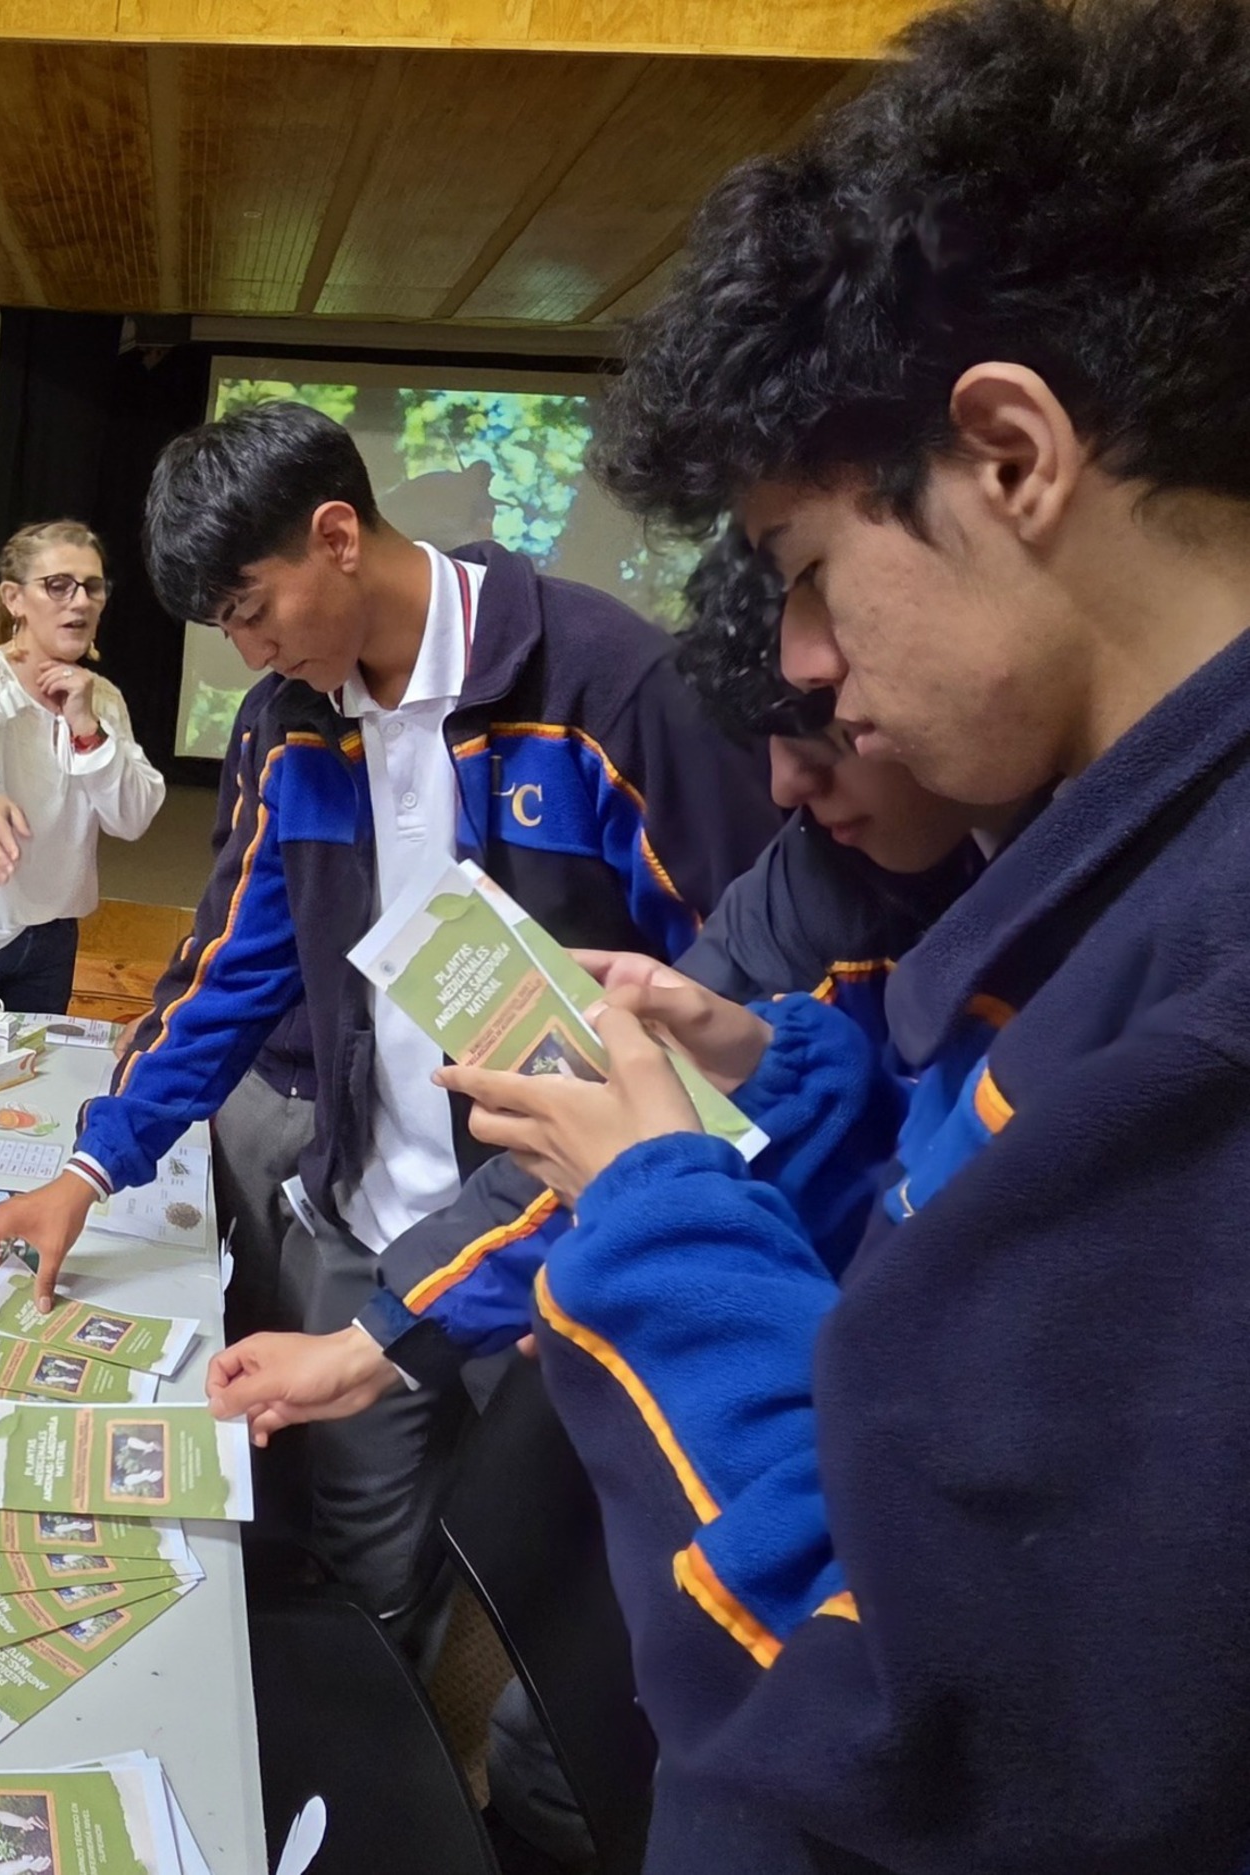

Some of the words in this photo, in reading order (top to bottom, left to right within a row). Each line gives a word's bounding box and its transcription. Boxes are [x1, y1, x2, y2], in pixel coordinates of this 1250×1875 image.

[434, 943, 472, 986] PLANTAS
[436, 945, 490, 1005] MEDICINALES
[434, 988, 474, 1031] ANDINAS:
[465, 977, 503, 1018] NATURAL
[24, 1439, 37, 1476] PLANTAS
[34, 1430, 47, 1486] MEDICINALES
[55, 1440, 67, 1478] NATURAL
